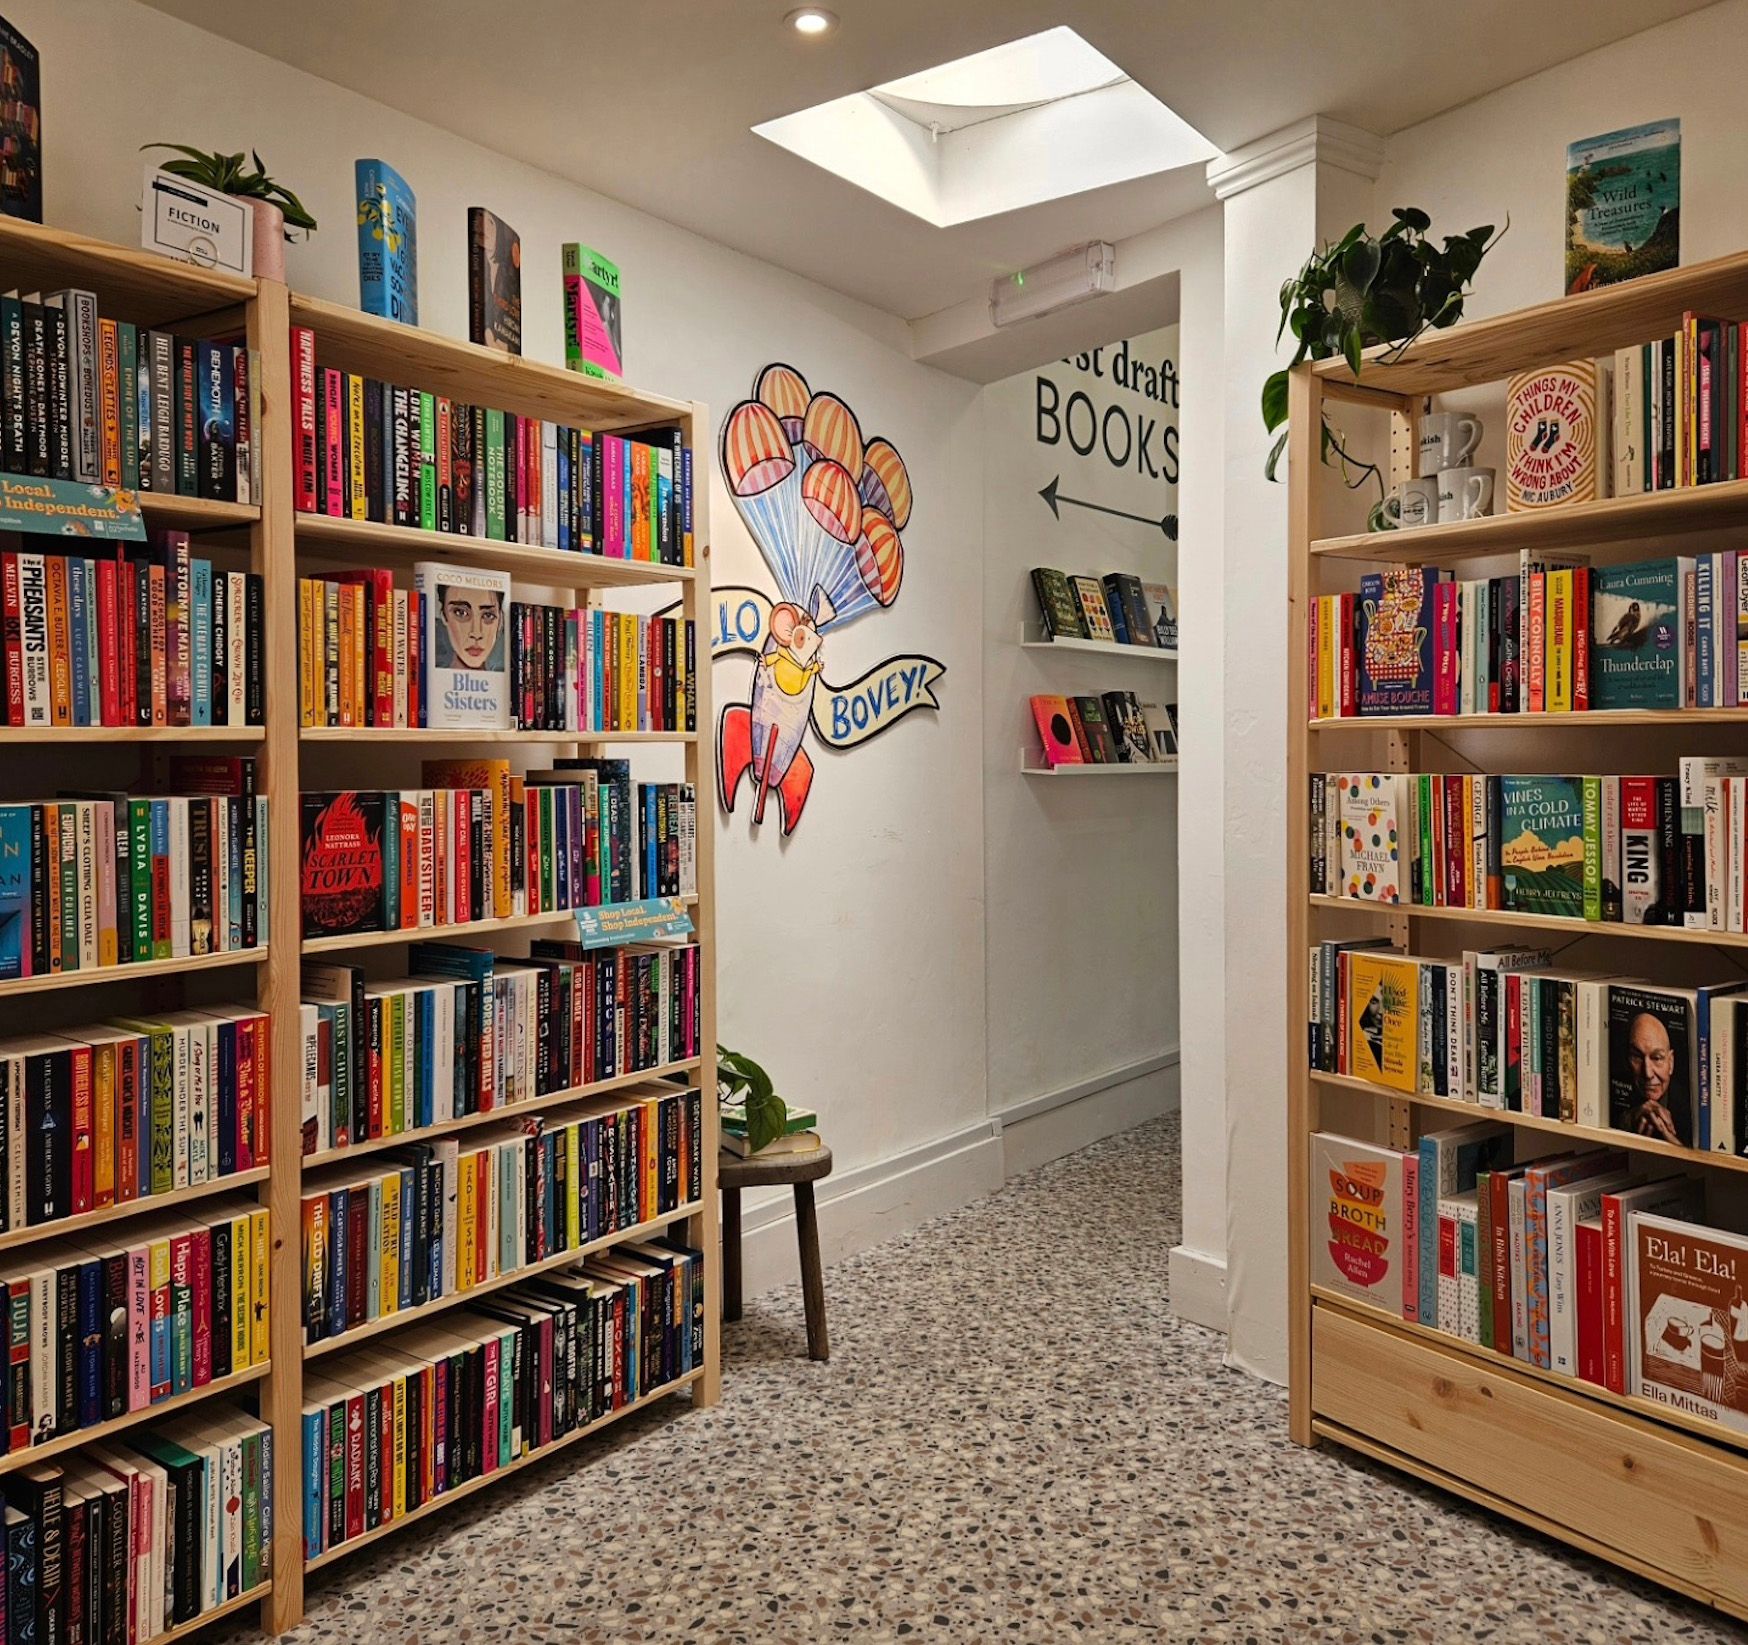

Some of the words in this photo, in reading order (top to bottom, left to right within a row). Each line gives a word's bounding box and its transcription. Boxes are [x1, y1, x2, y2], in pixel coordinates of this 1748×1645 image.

[1589, 201, 1653, 221] Treasures
[1602, 185, 1637, 203] Wild
[168, 206, 221, 234] FICTION
[56, 322, 66, 359] DEVON
[81, 300, 92, 356] BOOKSHOPS
[104, 331, 115, 371] LEGENDS
[156, 337, 168, 361] HELL
[299, 330, 312, 394] HAPPINESS
[58, 363, 68, 421] MIDWINTER
[84, 368, 93, 416] BONEDUST
[124, 367, 135, 402] EMPIRE
[156, 364, 169, 389] BENT
[210, 350, 222, 415] BEHEMOTH
[329, 373, 338, 409] BRIGHT
[1112, 340, 1179, 409] draft
[1515, 377, 1556, 407] THINGS
[1559, 379, 1580, 398] MY
[105, 384, 115, 421] LATTES
[125, 406, 135, 421] OF
[157, 394, 169, 423] LEIGH
[301, 397, 313, 430] FALLS
[395, 389, 407, 418] THE
[410, 389, 421, 423] LONE
[1514, 395, 1582, 434] CHILDREN
[38, 402, 47, 458] DARTMOOR
[60, 425, 69, 469] MURDER
[126, 423, 135, 442] THE
[1037, 375, 1179, 486] BOOKS
[126, 445, 135, 467] SUN
[158, 425, 170, 472] BARDUGO
[211, 442, 219, 480] BAXTER
[304, 433, 313, 467] ANGIE
[395, 418, 409, 502] CHANGELING
[411, 429, 421, 479] WOMEN
[1519, 449, 1553, 473] THINK
[1554, 442, 1577, 467] I'M
[3, 480, 56, 499] Local.
[304, 470, 313, 494] KIM
[487, 446, 496, 515] NOTEBOOK
[1511, 464, 1546, 490] WRONG
[1549, 456, 1583, 487] ABOUT
[5, 496, 121, 519] Independent.
[496, 471, 505, 520] GOLDEN
[1521, 491, 1535, 502] NIC
[1536, 483, 1574, 503] AUBURY
[177, 541, 188, 564] THE
[6, 563, 17, 608] MELVIN
[52, 563, 62, 604] OCTAVIA
[177, 567, 188, 609] STORM
[1531, 580, 1542, 613] BILLY
[1625, 573, 1674, 590] Cumming
[1699, 563, 1710, 613] KILLING
[22, 566, 46, 653] PHEASANTS
[215, 578, 224, 625] CATHERINE
[397, 599, 405, 635] NORTH
[54, 617, 64, 650] BUTLER
[178, 612, 189, 631] WE
[178, 632, 189, 667] MADE
[216, 627, 225, 667] CHIDGEY
[397, 639, 405, 676] WATER
[1441, 650, 1449, 674] FOUR
[1531, 615, 1542, 686] CONNOLLY
[1599, 654, 1675, 674] Thunderclap
[9, 651, 21, 705] BURGESS
[37, 656, 45, 682] STEVE
[453, 672, 489, 692] Blue
[444, 691, 498, 711] Sisters
[687, 672, 695, 716] WHALE
[831, 664, 928, 740] BOVEY!
[1361, 691, 1390, 705] AMUSE
[1390, 690, 1430, 704] BOUCHE
[1473, 781, 1483, 828] GEORGE
[1503, 788, 1542, 805] VINES
[1505, 805, 1516, 816] IN
[1517, 805, 1525, 815] A
[1528, 799, 1569, 816] COLD
[1585, 783, 1596, 833] TOMMY
[1663, 782, 1673, 823] STEPHEN
[1704, 786, 1719, 815] milk
[82, 808, 91, 845] SHEEP'S
[668, 795, 678, 837] RETREAT
[1520, 814, 1582, 832] CLIMATE
[117, 831, 128, 859] CLEAR
[137, 825, 147, 871] LYDIA
[1664, 823, 1673, 848] KING
[84, 847, 92, 891] CLOTHING
[244, 848, 255, 894] KEEPER
[310, 848, 379, 868] SCARLET
[421, 827, 432, 912] BABYSITTER
[1349, 850, 1391, 863] MICHAEL
[1356, 860, 1385, 874] FRAYN
[1585, 836, 1596, 884] JESSOP
[1626, 835, 1649, 884] KING
[309, 867, 372, 890] TOWN
[138, 893, 148, 939] DAVIS
[599, 909, 622, 921] Shop
[601, 921, 624, 932] Shop
[85, 923, 93, 946] DALE
[481, 970, 493, 995] THE
[1611, 994, 1645, 1009] PATRICK
[1646, 998, 1686, 1015] STEWART
[335, 1007, 347, 1047] DUST
[482, 996, 493, 1058] BORROWED
[178, 1038, 187, 1077] MURDER
[336, 1051, 347, 1097] CHILD
[482, 1059, 493, 1091] HILLS
[178, 1080, 187, 1112] UNDER
[179, 1115, 187, 1134] THE
[179, 1136, 187, 1156] SUN
[1336, 1179, 1381, 1202] SOUP
[1405, 1168, 1418, 1196] Mary
[312, 1202, 324, 1229] THE
[1330, 1200, 1387, 1232] BROTH
[1405, 1199, 1418, 1239] Berry's
[1554, 1203, 1564, 1229] ANNA
[214, 1233, 227, 1268] Grady
[312, 1231, 324, 1259] OLD
[335, 1211, 344, 1276] CARTOGRAPHERS
[1344, 1253, 1372, 1269] Rachel
[1554, 1231, 1564, 1264] JONES
[1645, 1236, 1687, 1267] Ela!
[1694, 1248, 1737, 1281] Ela!
[175, 1242, 190, 1288] Happy
[312, 1262, 324, 1300] DRIFT
[1496, 1264, 1506, 1300] Kitchen
[1607, 1255, 1616, 1279] Love
[41, 1279, 49, 1320] EVERYBODY
[135, 1291, 145, 1315] LOVE
[216, 1268, 227, 1311] Hendrix
[13, 1299, 28, 1343] JUJA
[154, 1287, 166, 1332] Lovers
[177, 1289, 190, 1327] Place
[486, 1359, 495, 1375] IT
[486, 1375, 496, 1410] GIRL
[1641, 1383, 1667, 1402] Ella
[1669, 1392, 1718, 1420] Mittas
[261, 1435, 270, 1470] Soldier
[350, 1432, 361, 1492] RADIANCE
[44, 1487, 61, 1526] HELLE
[260, 1506, 270, 1536] Claire
[113, 1501, 124, 1568] GODKILLER
[44, 1546, 61, 1591] DEATH
